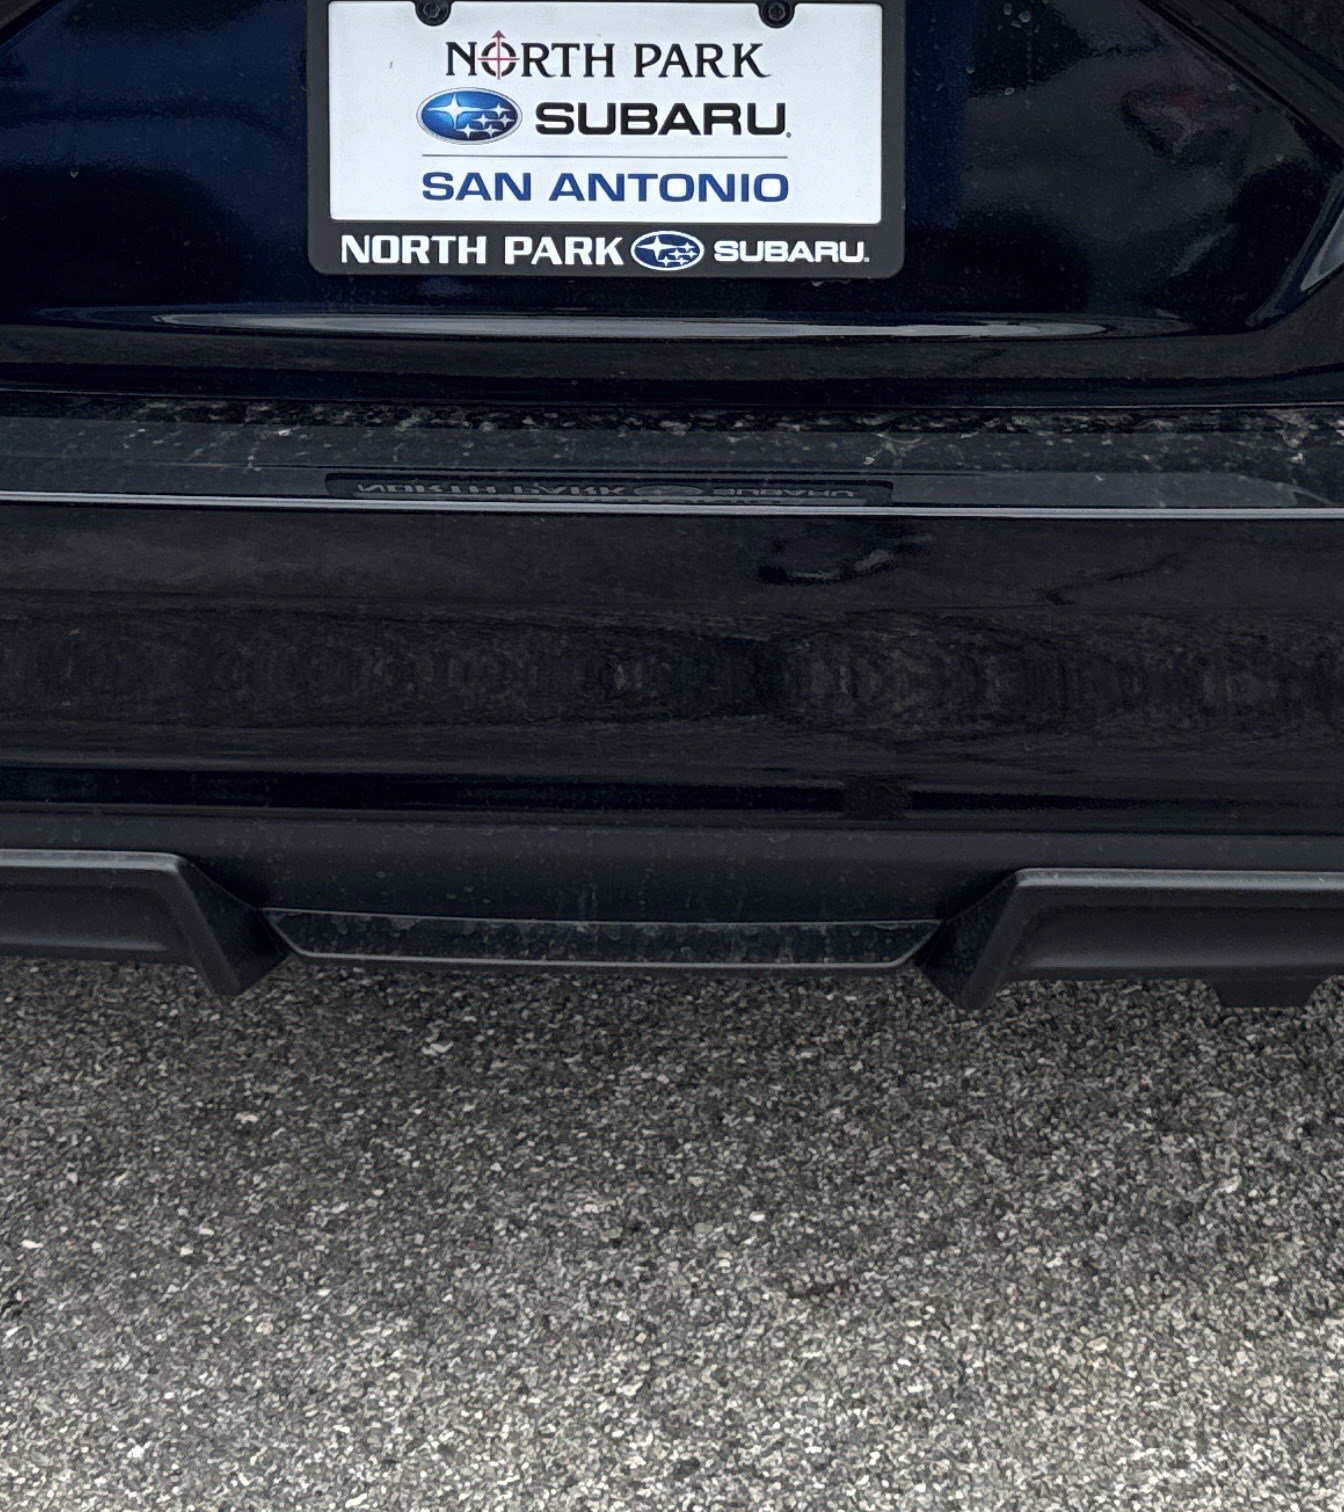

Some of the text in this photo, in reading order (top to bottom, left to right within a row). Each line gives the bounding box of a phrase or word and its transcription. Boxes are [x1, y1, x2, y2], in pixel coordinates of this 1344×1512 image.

[445, 37, 771, 80] NORTH PARK
[535, 101, 787, 137] SUBARU
[422, 171, 789, 203] SAN ANTONIO
[341, 234, 866, 266] NORTH PARK SUBARU
